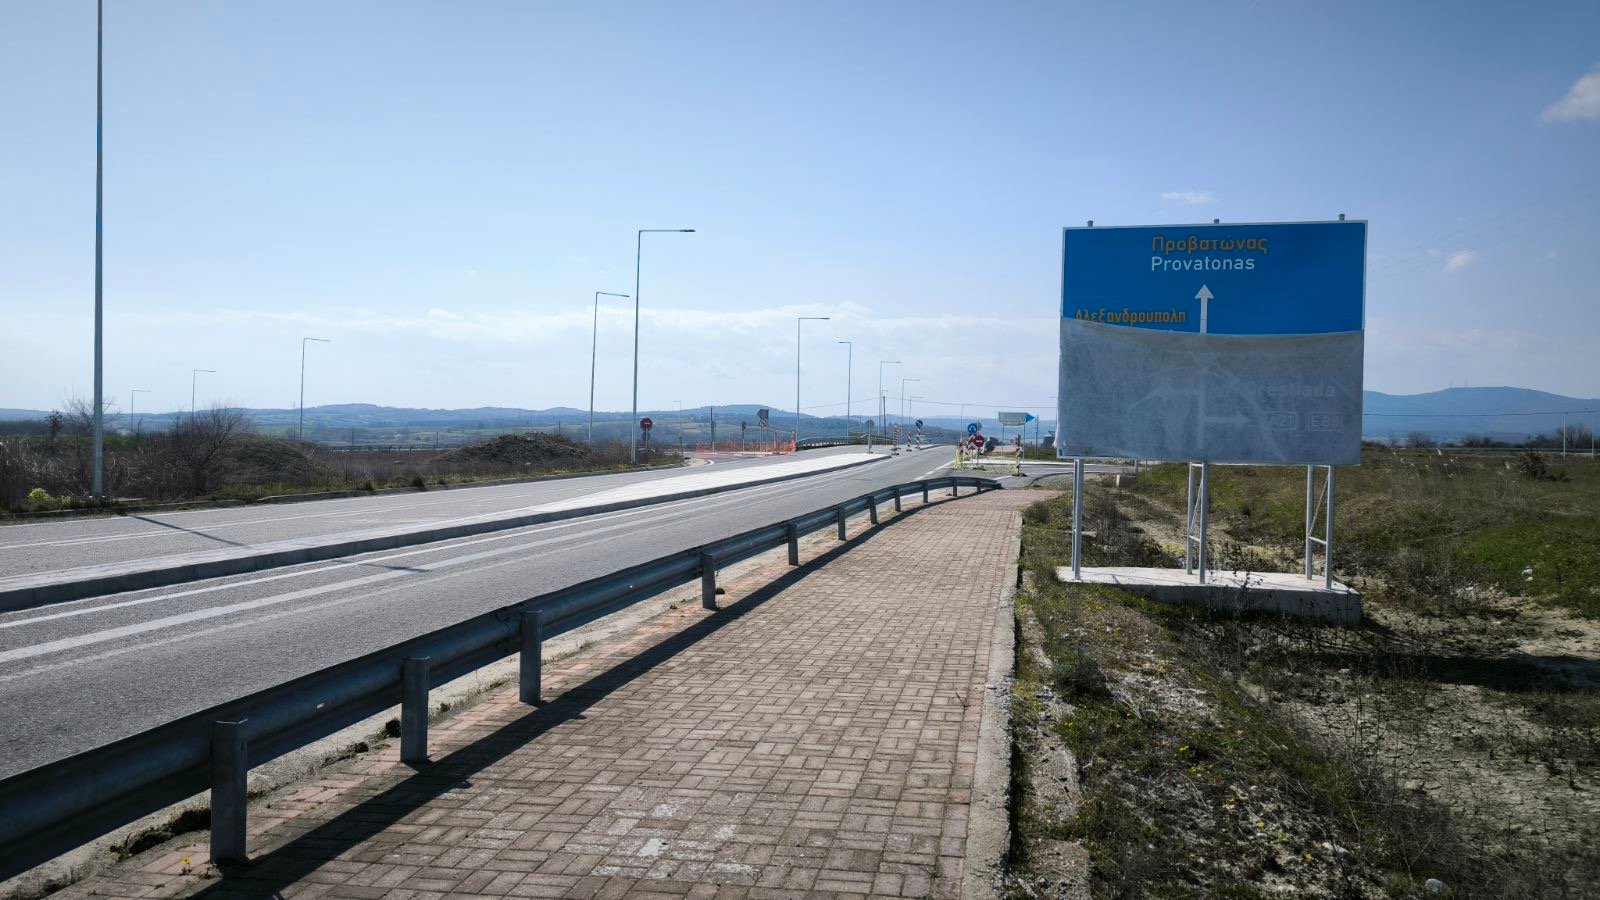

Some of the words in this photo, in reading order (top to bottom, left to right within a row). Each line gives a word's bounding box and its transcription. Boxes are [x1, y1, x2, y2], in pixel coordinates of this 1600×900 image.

[1151, 235, 1269, 255] Προβατώνας
[1151, 256, 1255, 271] Provatonas
[1250, 381, 1336, 397] restiada
